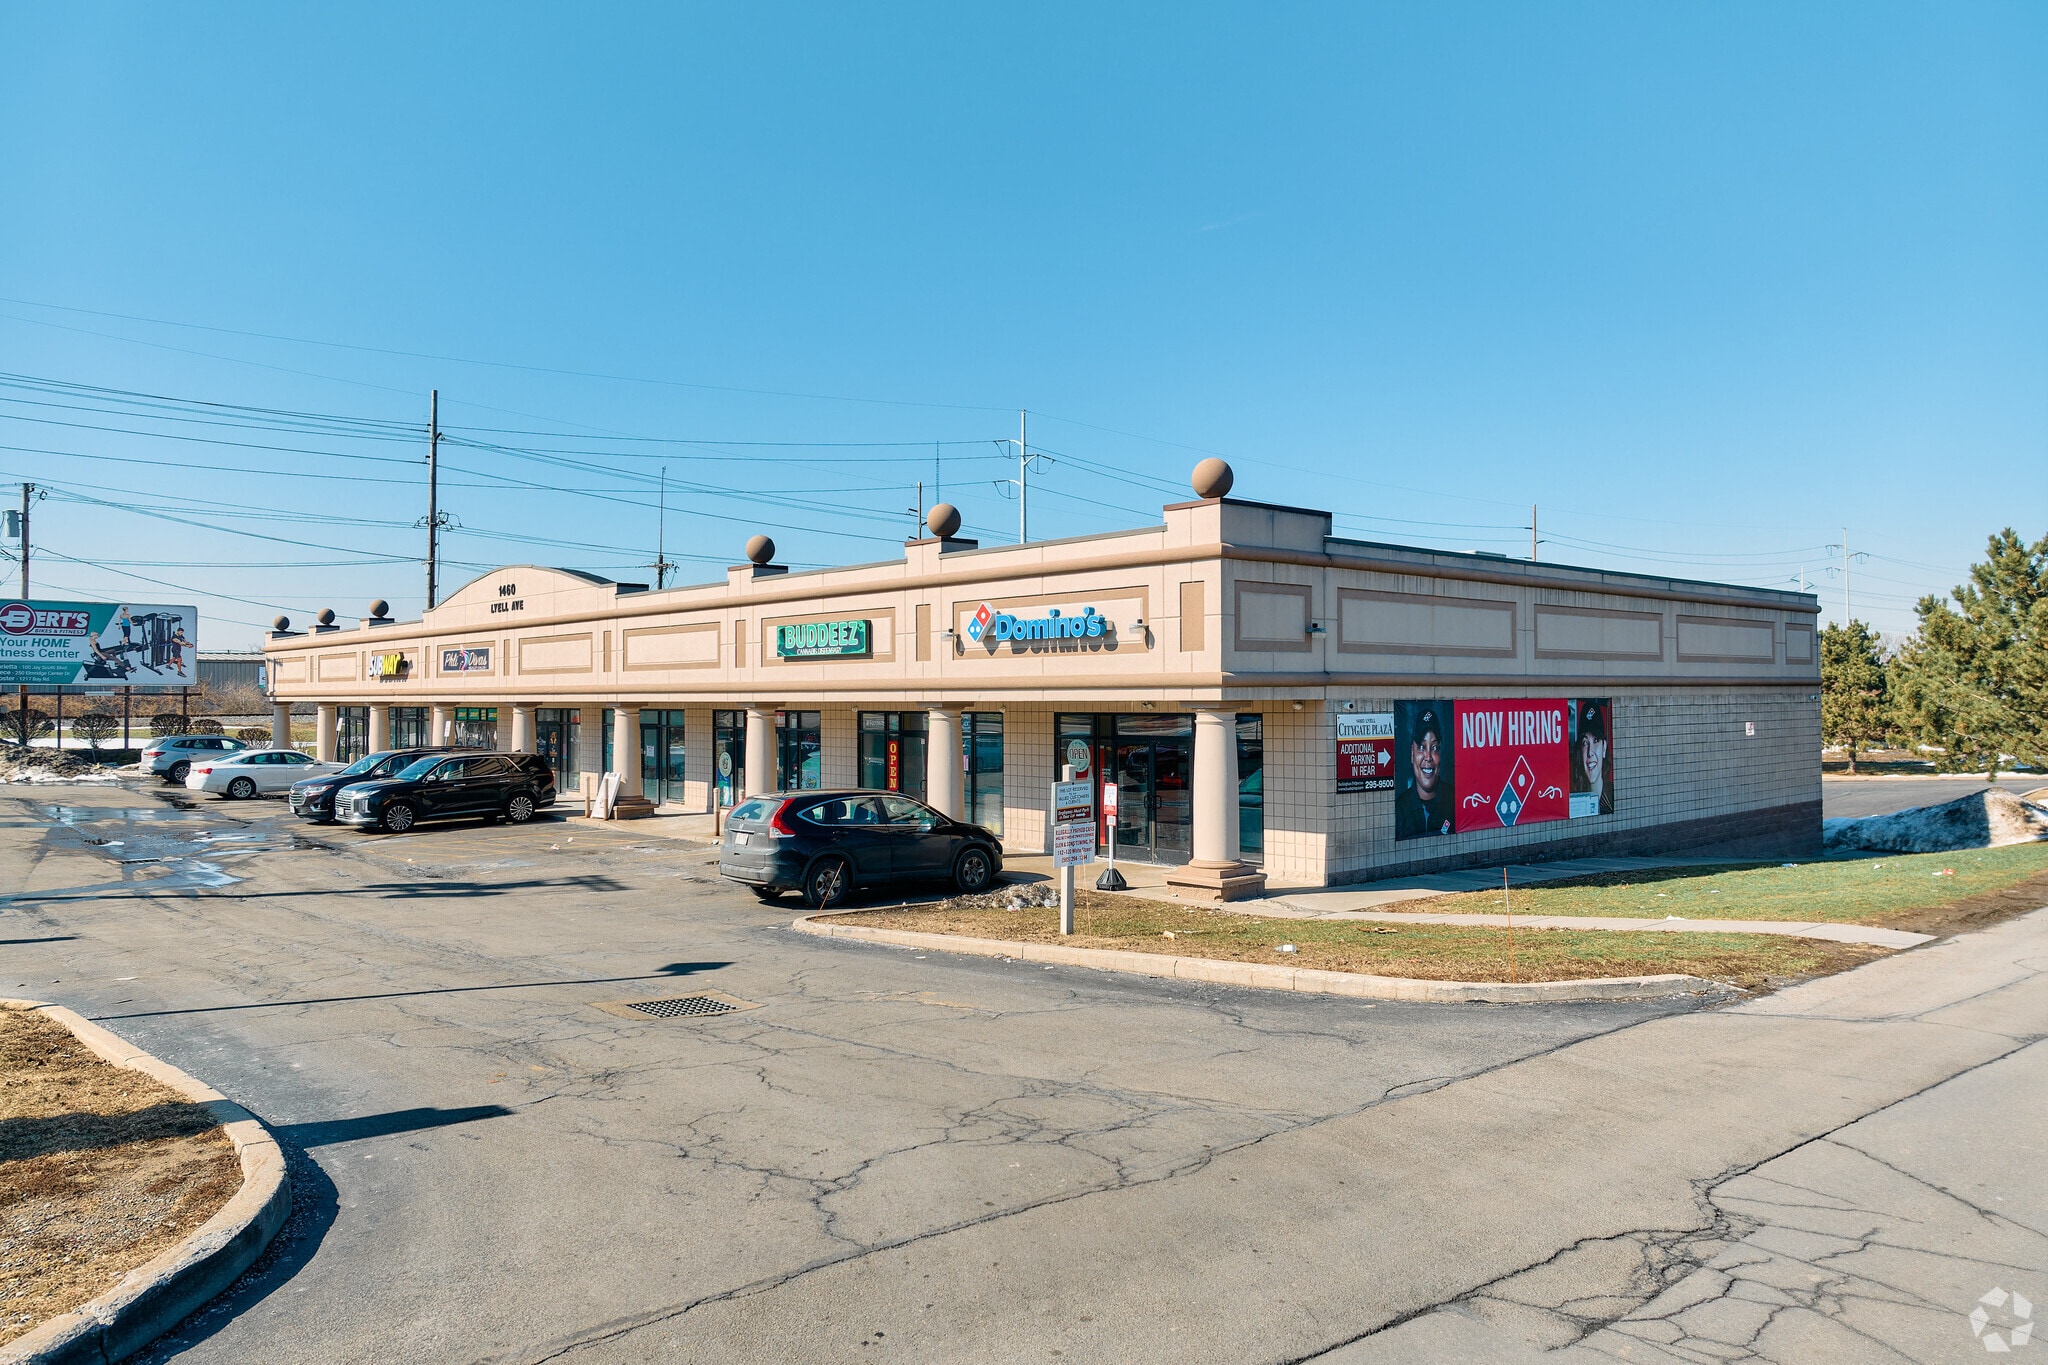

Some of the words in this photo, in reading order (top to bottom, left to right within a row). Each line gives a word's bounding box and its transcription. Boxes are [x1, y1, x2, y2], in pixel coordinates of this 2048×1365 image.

[499, 584, 516, 597] 1460
[491, 602, 509, 613] LYELL
[511, 600, 524, 611] AVE
[0, 610, 89, 628] BERT'S
[995, 606, 1107, 641] Domino's
[784, 621, 859, 649] BUDDEEZ
[0, 637, 28, 647] Your
[31, 638, 72, 648] HOME
[38, 648, 80, 659] Center
[369, 652, 402, 677] SUBWAY
[1371, 722, 1393, 736] PLAZA
[1462, 711, 1503, 749] NOW
[1508, 710, 1562, 746] HIRING
[1069, 748, 1088, 760] OPEN
[1340, 743, 1375, 755] ADDITIONAL
[889, 743, 898, 789] OPEN
[1350, 754, 1376, 766] PARKING
[1351, 766, 1358, 776] IN
[1359, 765, 1376, 776] REAR
[1365, 779, 1394, 789] 295-9500
